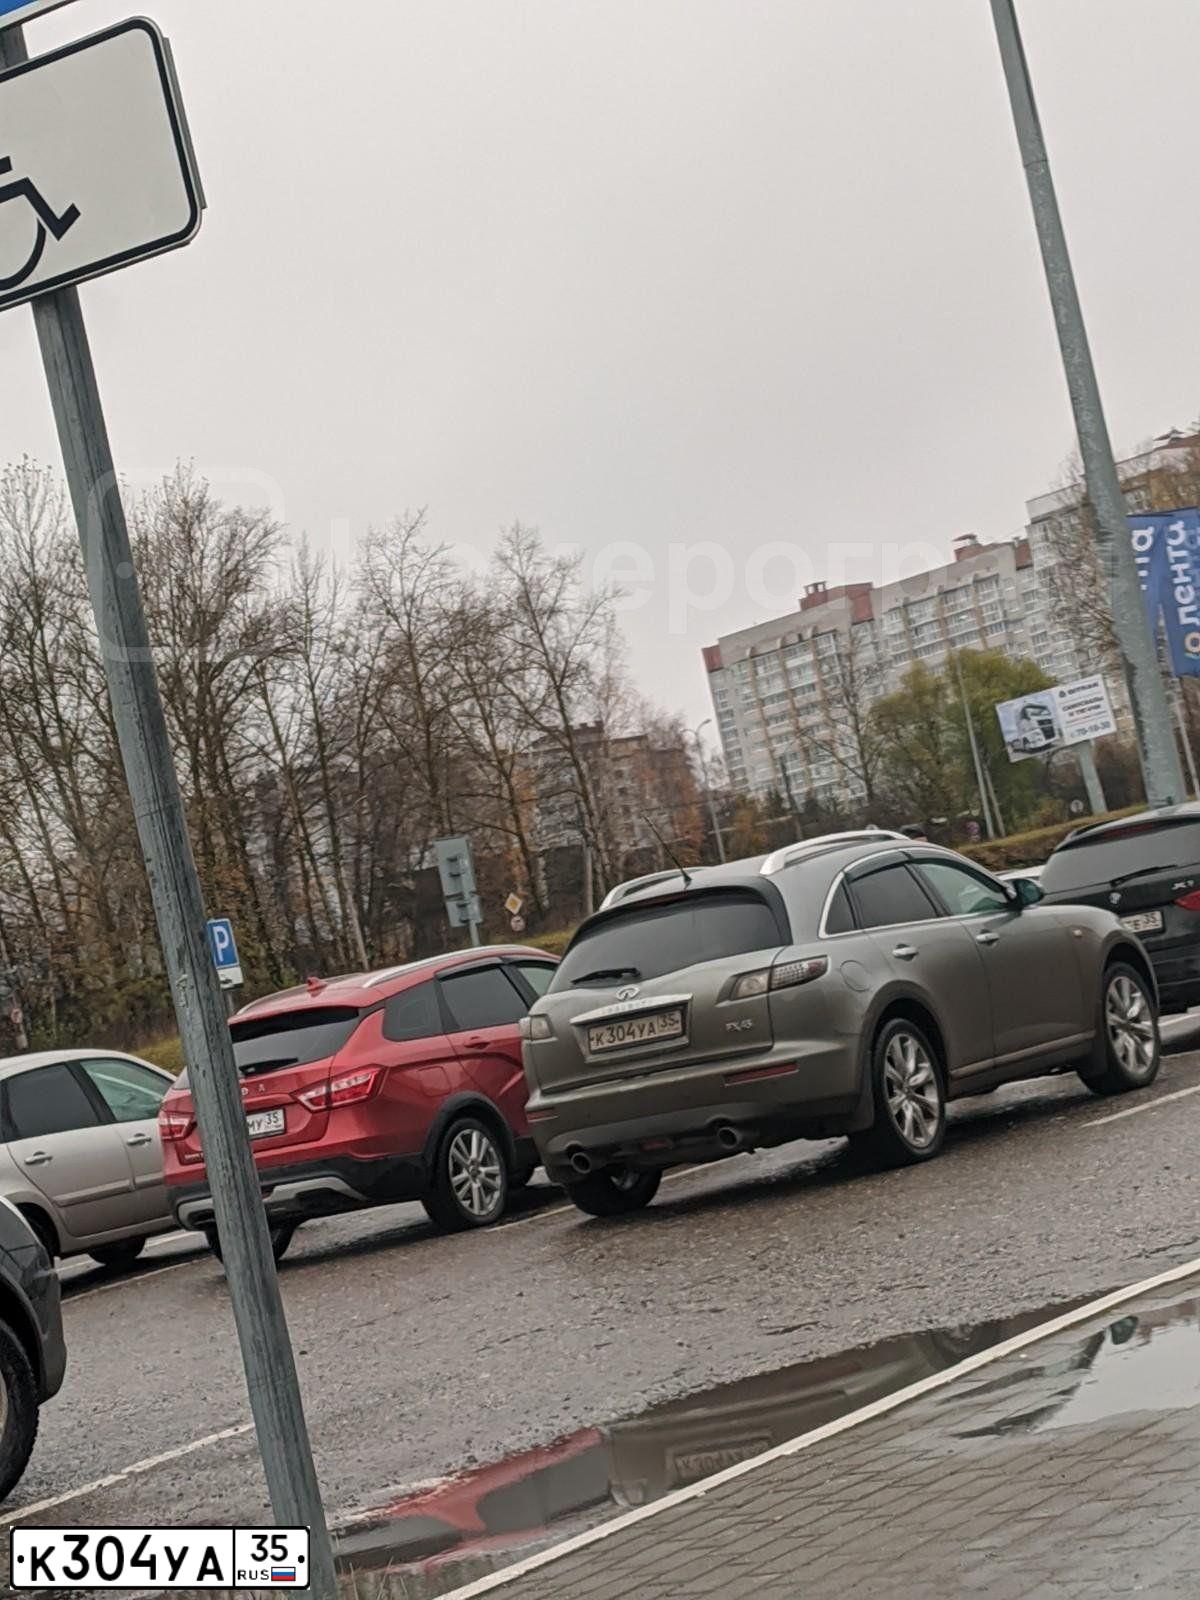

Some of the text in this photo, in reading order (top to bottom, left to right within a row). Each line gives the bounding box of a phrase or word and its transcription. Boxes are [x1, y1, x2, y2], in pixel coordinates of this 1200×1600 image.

[1166, 520, 1200, 626] лента
[213, 926, 229, 962] P
[595, 1012, 676, 1046] К304УА 35
[266, 1112, 279, 1124] 35
